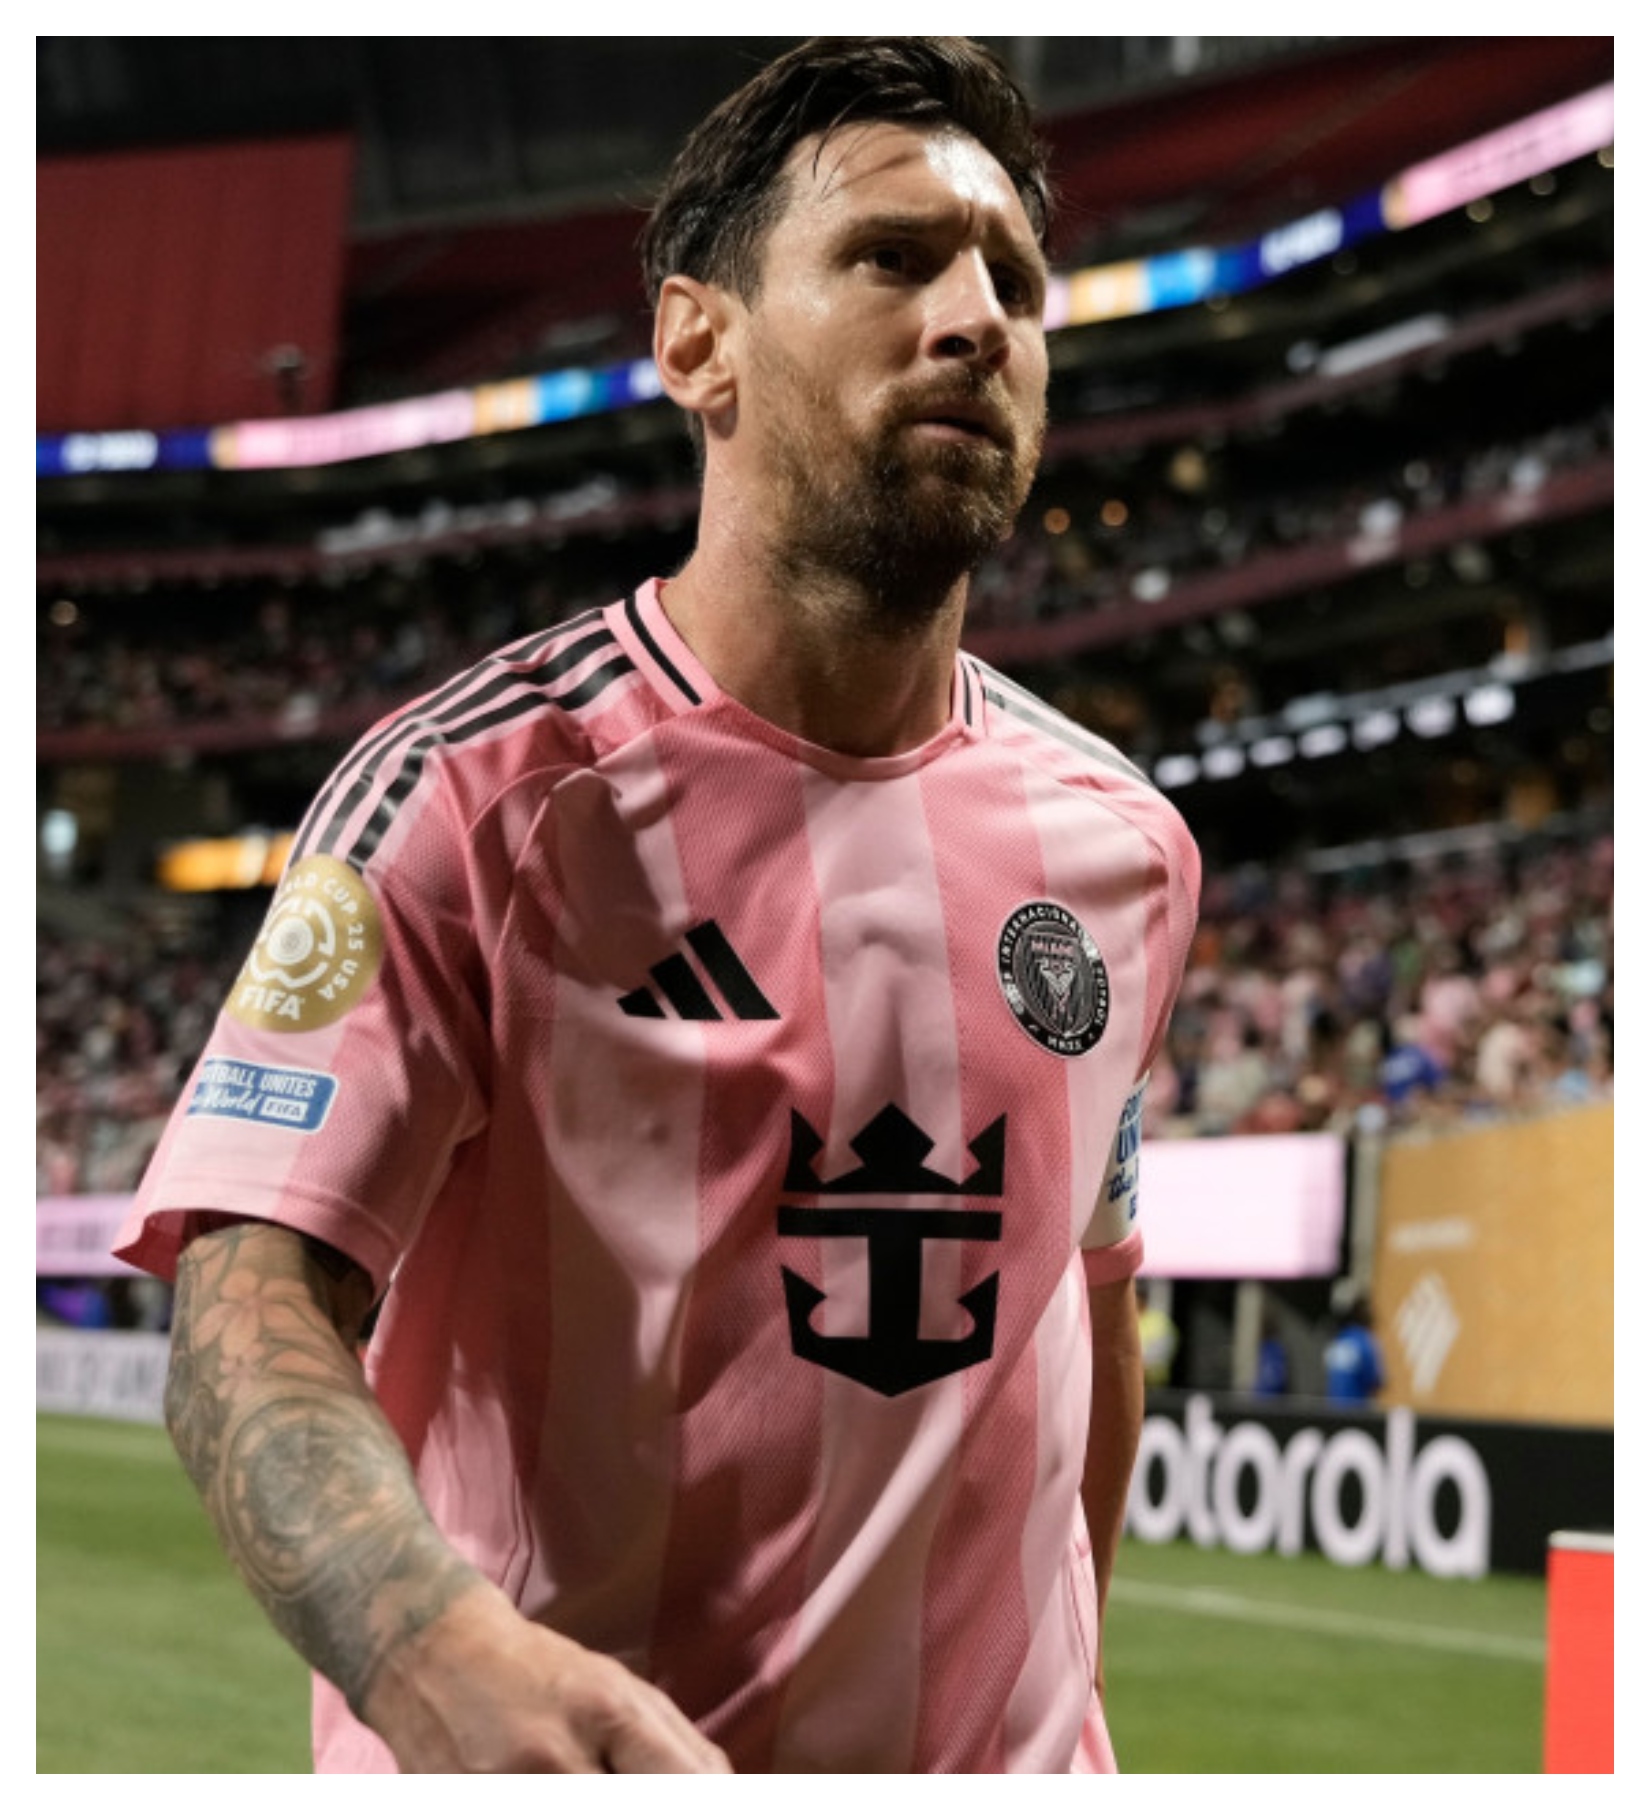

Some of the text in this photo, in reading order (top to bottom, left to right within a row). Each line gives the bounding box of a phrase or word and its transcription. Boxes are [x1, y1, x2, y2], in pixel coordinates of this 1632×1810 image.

[322, 877, 359, 914] CUP
[347, 923, 366, 952] 25
[317, 958, 360, 1001] USA
[236, 984, 301, 1021] FIFA
[259, 1072, 318, 1098] UNITES
[265, 1100, 302, 1118] FIFA
[1123, 1394, 1492, 1580] otorola
